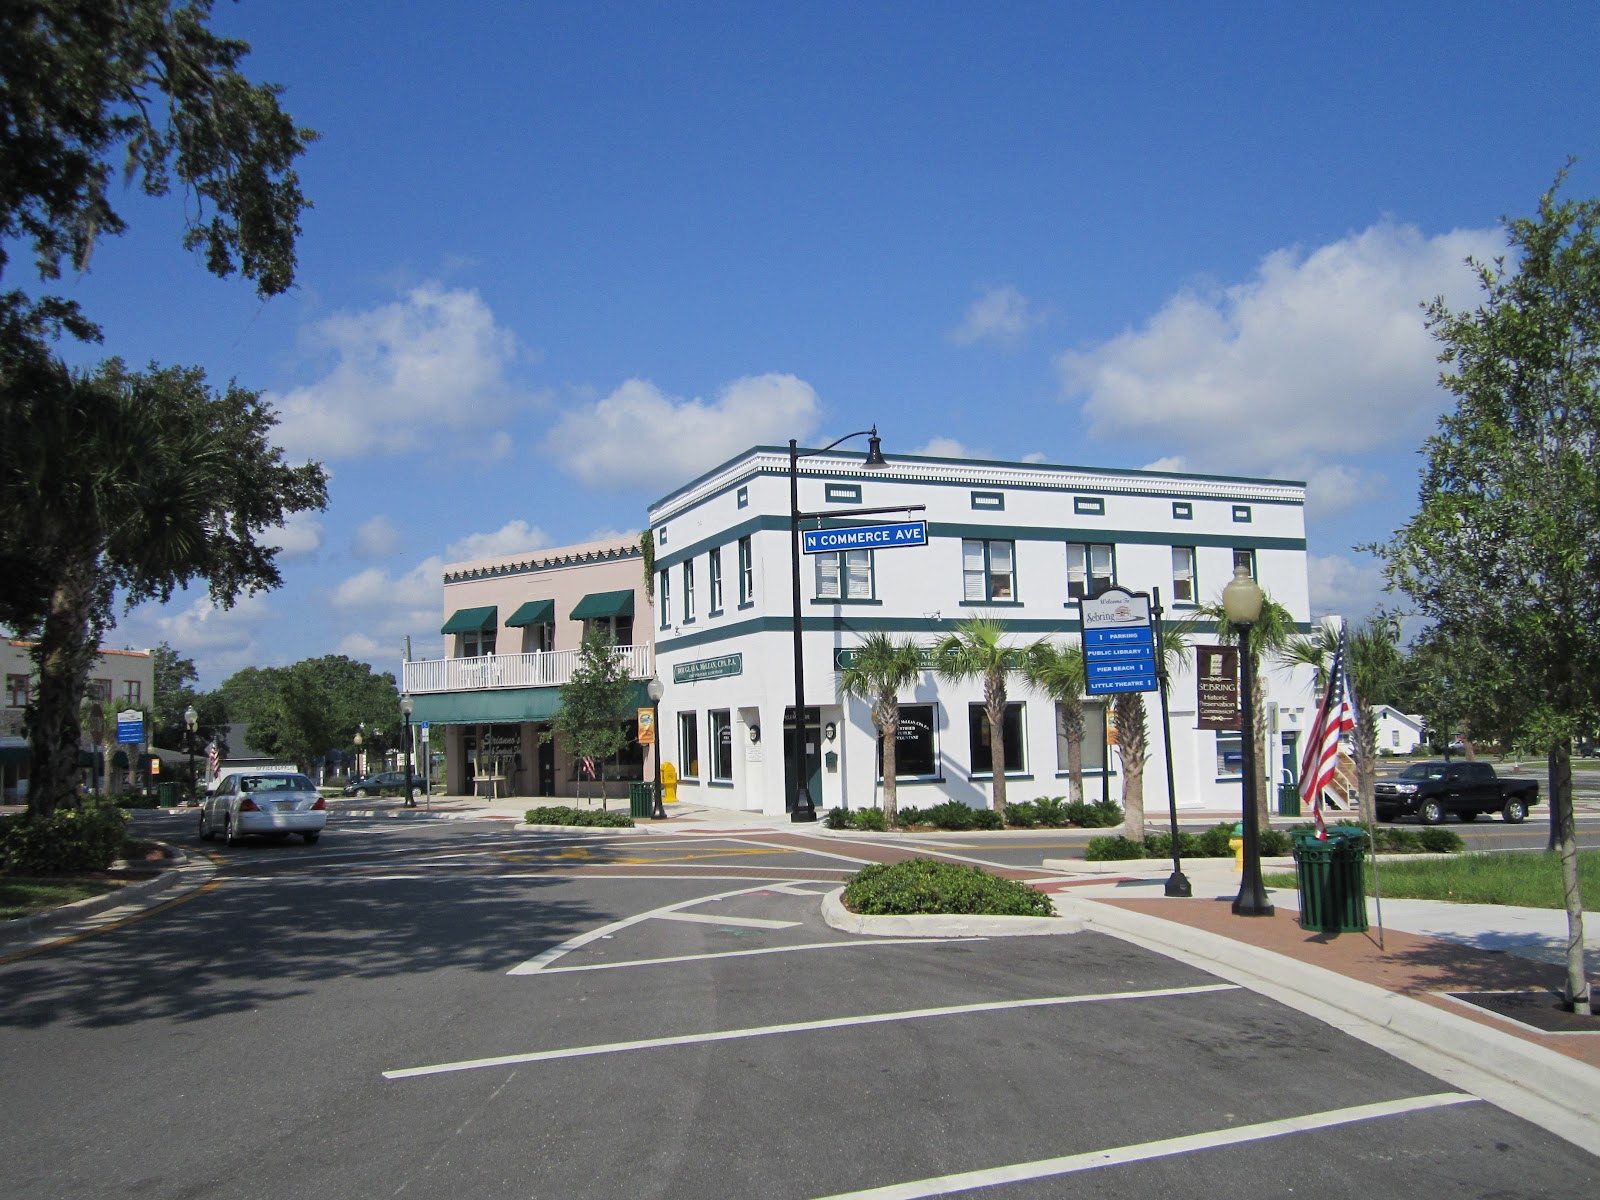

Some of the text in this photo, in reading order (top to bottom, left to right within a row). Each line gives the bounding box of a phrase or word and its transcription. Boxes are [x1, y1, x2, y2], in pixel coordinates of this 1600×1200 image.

[808, 528, 921, 547] N COMMERCE AVE
[1086, 611, 1115, 623] Sebring
[1199, 683, 1236, 692] SEBRING
